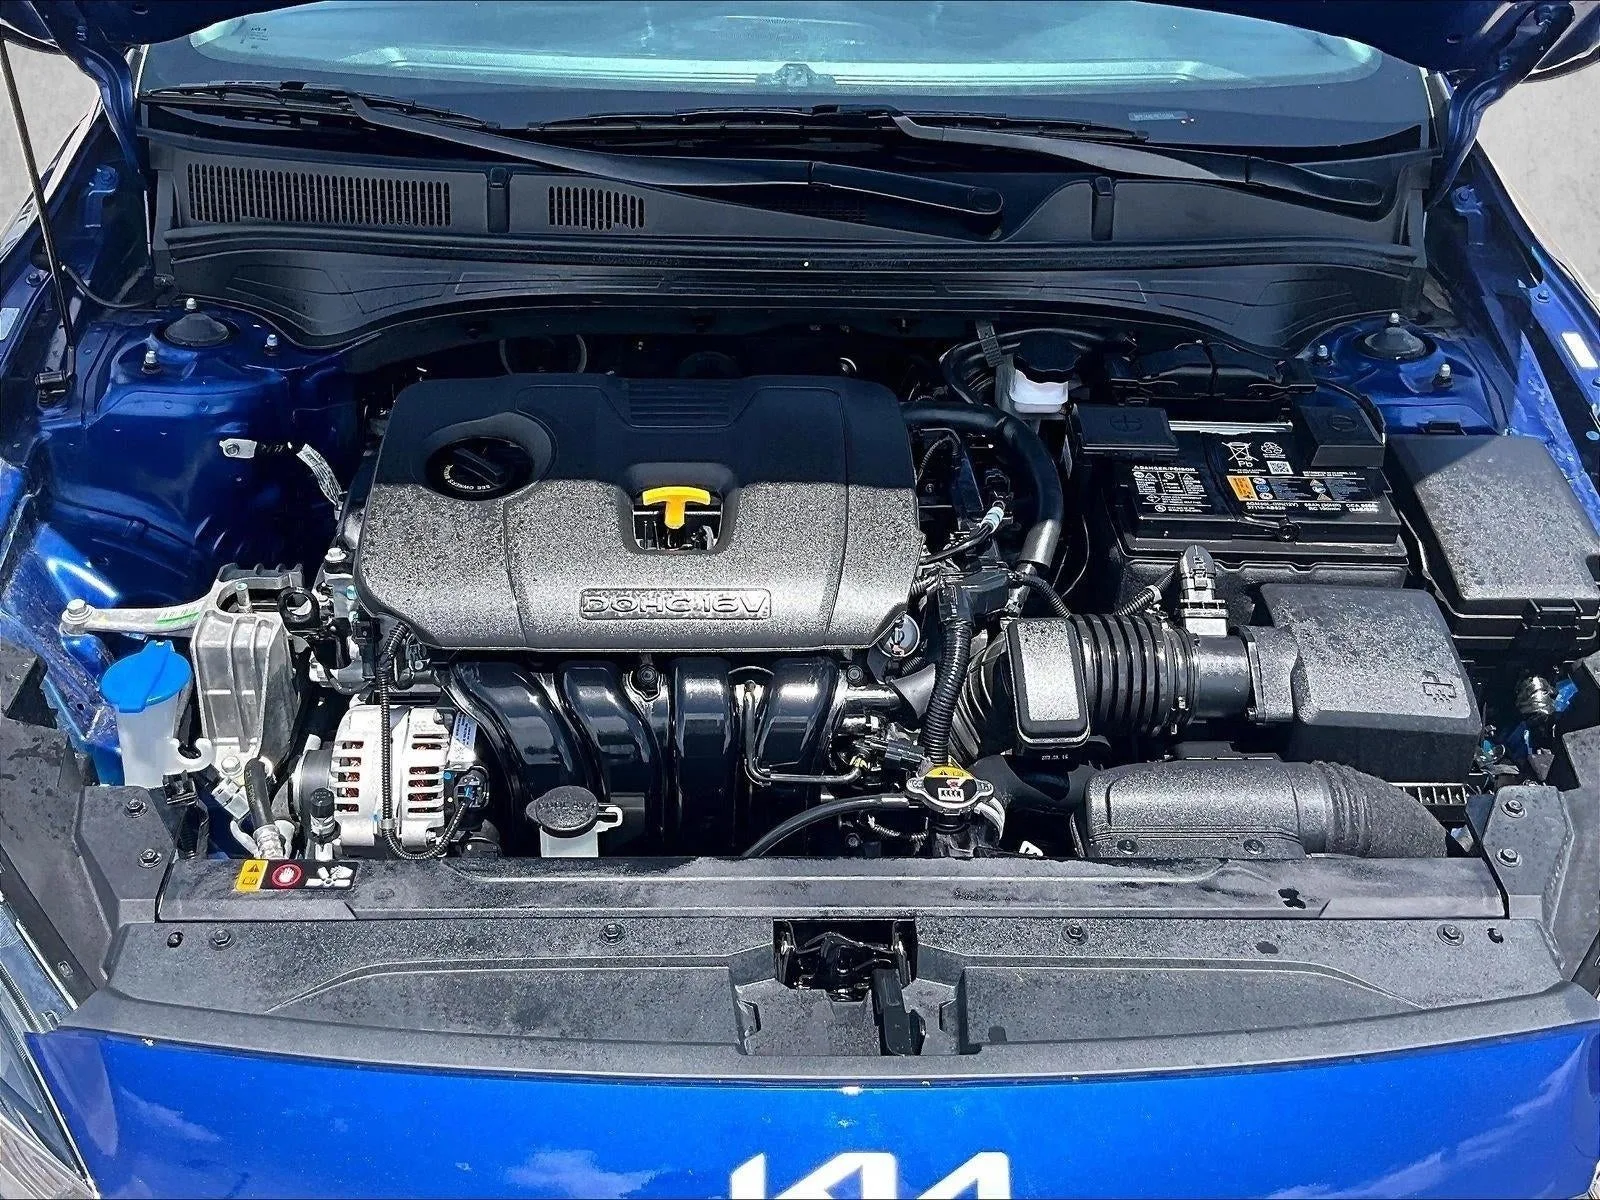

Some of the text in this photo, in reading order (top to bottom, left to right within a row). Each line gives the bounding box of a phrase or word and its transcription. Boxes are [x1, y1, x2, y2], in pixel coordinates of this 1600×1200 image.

[1238, 460, 1253, 468] Pb
[582, 595, 767, 613] DOHC 16V
